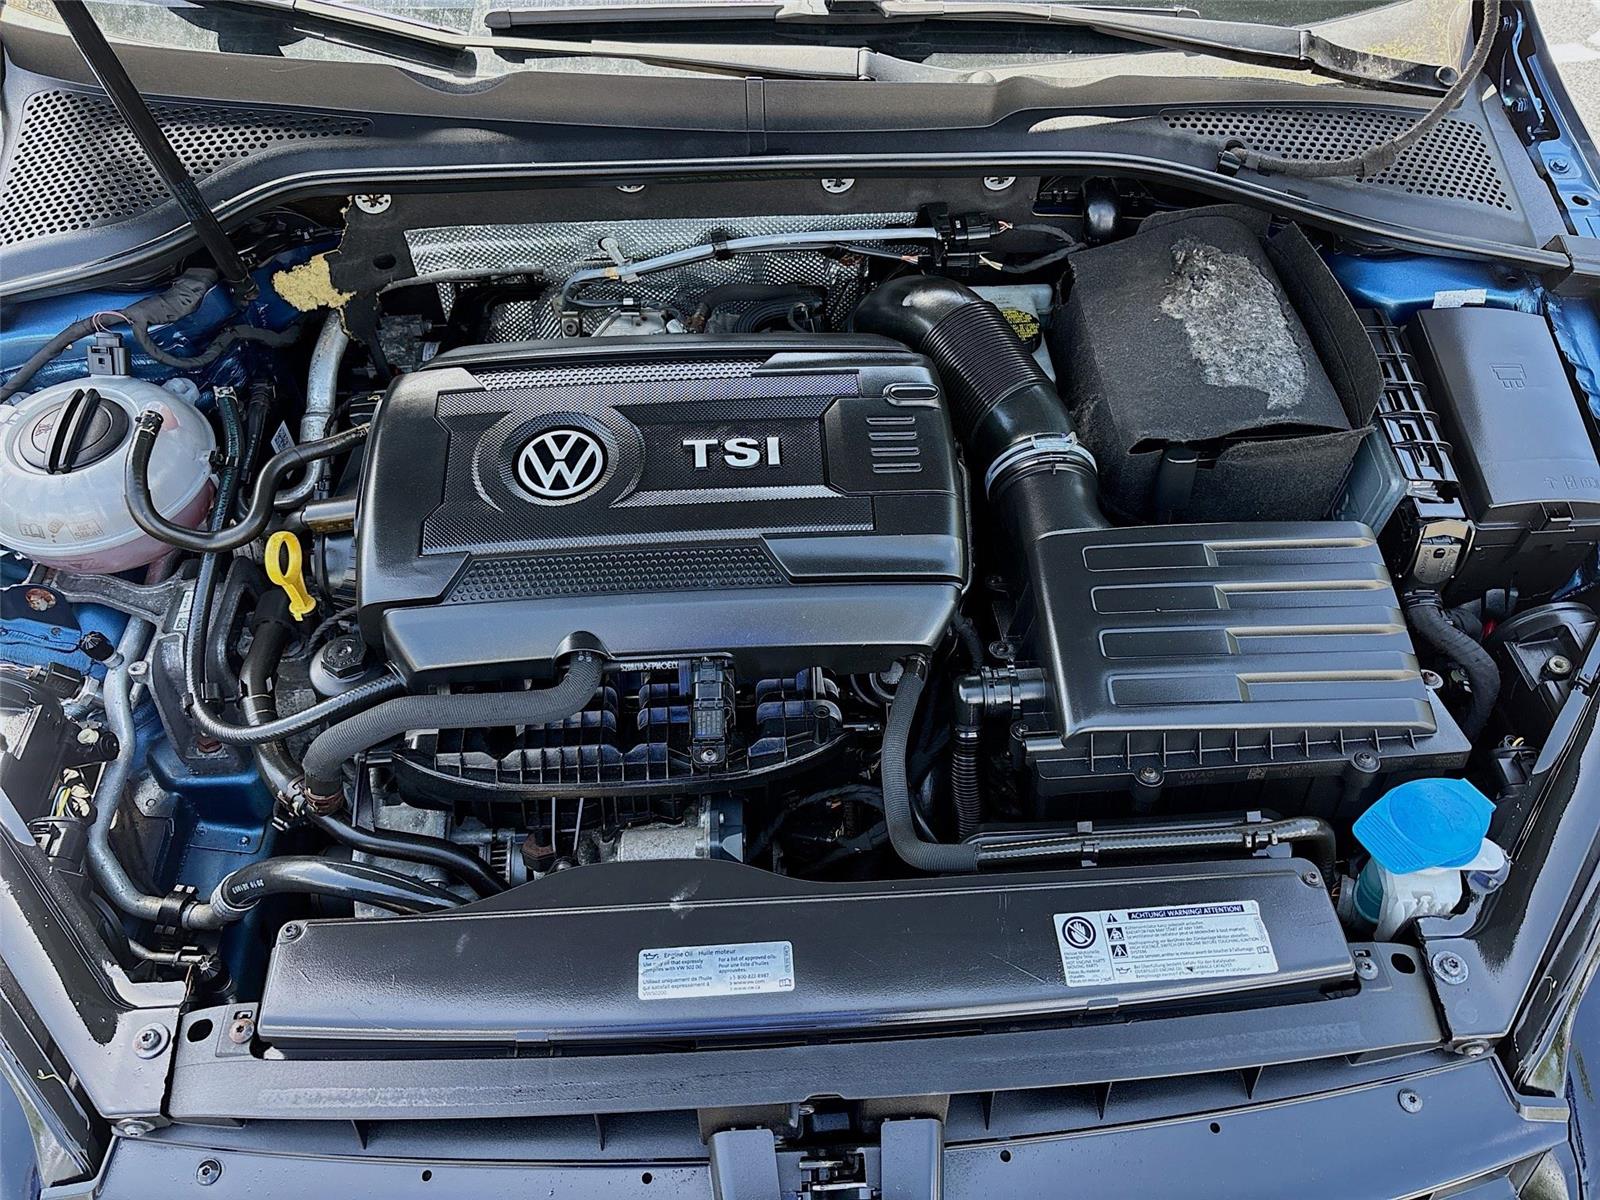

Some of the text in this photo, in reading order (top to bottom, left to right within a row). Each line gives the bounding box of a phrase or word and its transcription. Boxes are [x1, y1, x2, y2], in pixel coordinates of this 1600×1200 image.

[518, 430, 604, 496] VW
[683, 436, 781, 468] TSI
[1131, 905, 1242, 919] ACHTUNG! WARNING! ATTENTION!
